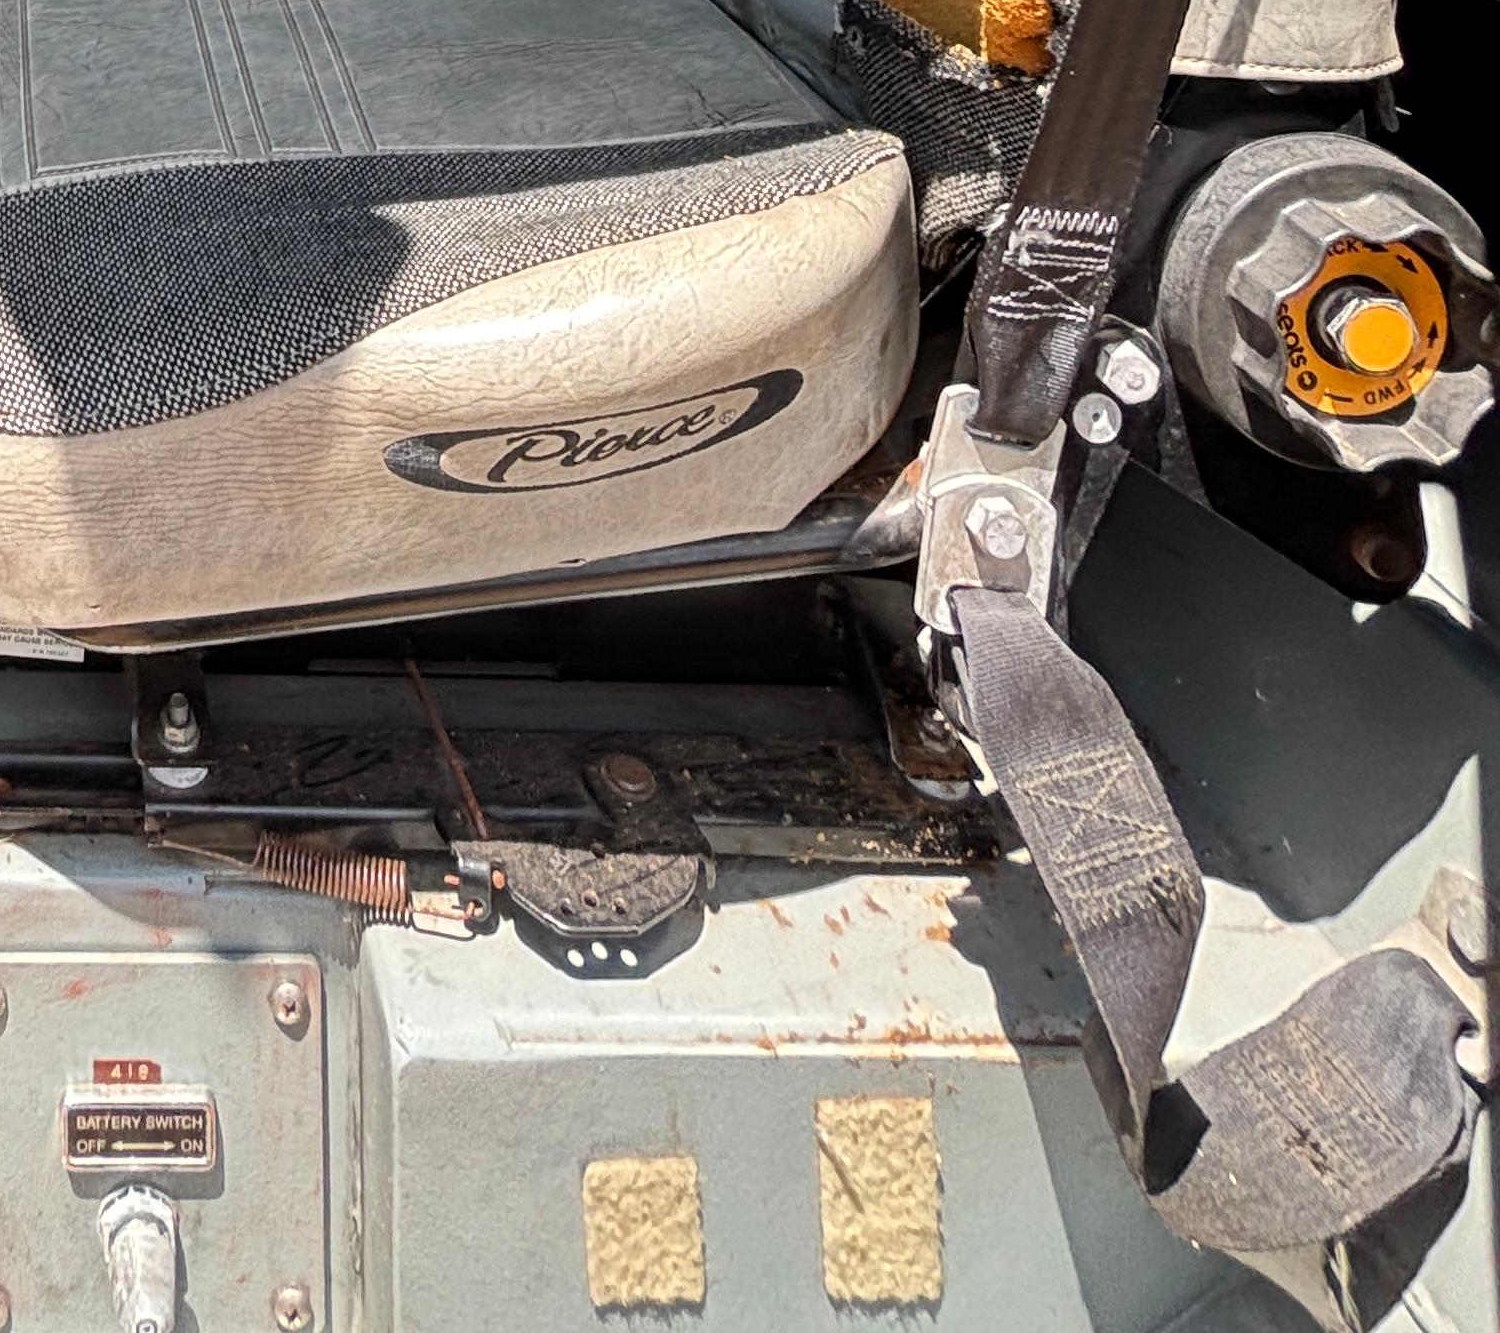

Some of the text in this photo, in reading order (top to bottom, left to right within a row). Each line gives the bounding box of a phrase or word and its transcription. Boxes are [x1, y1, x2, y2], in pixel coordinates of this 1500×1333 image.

[1364, 378, 1408, 406] FWD
[487, 404, 716, 483] Pierce
[76, 1115, 204, 1131] BATTERY SWITCH
[76, 1138, 204, 1153] OFF ON
